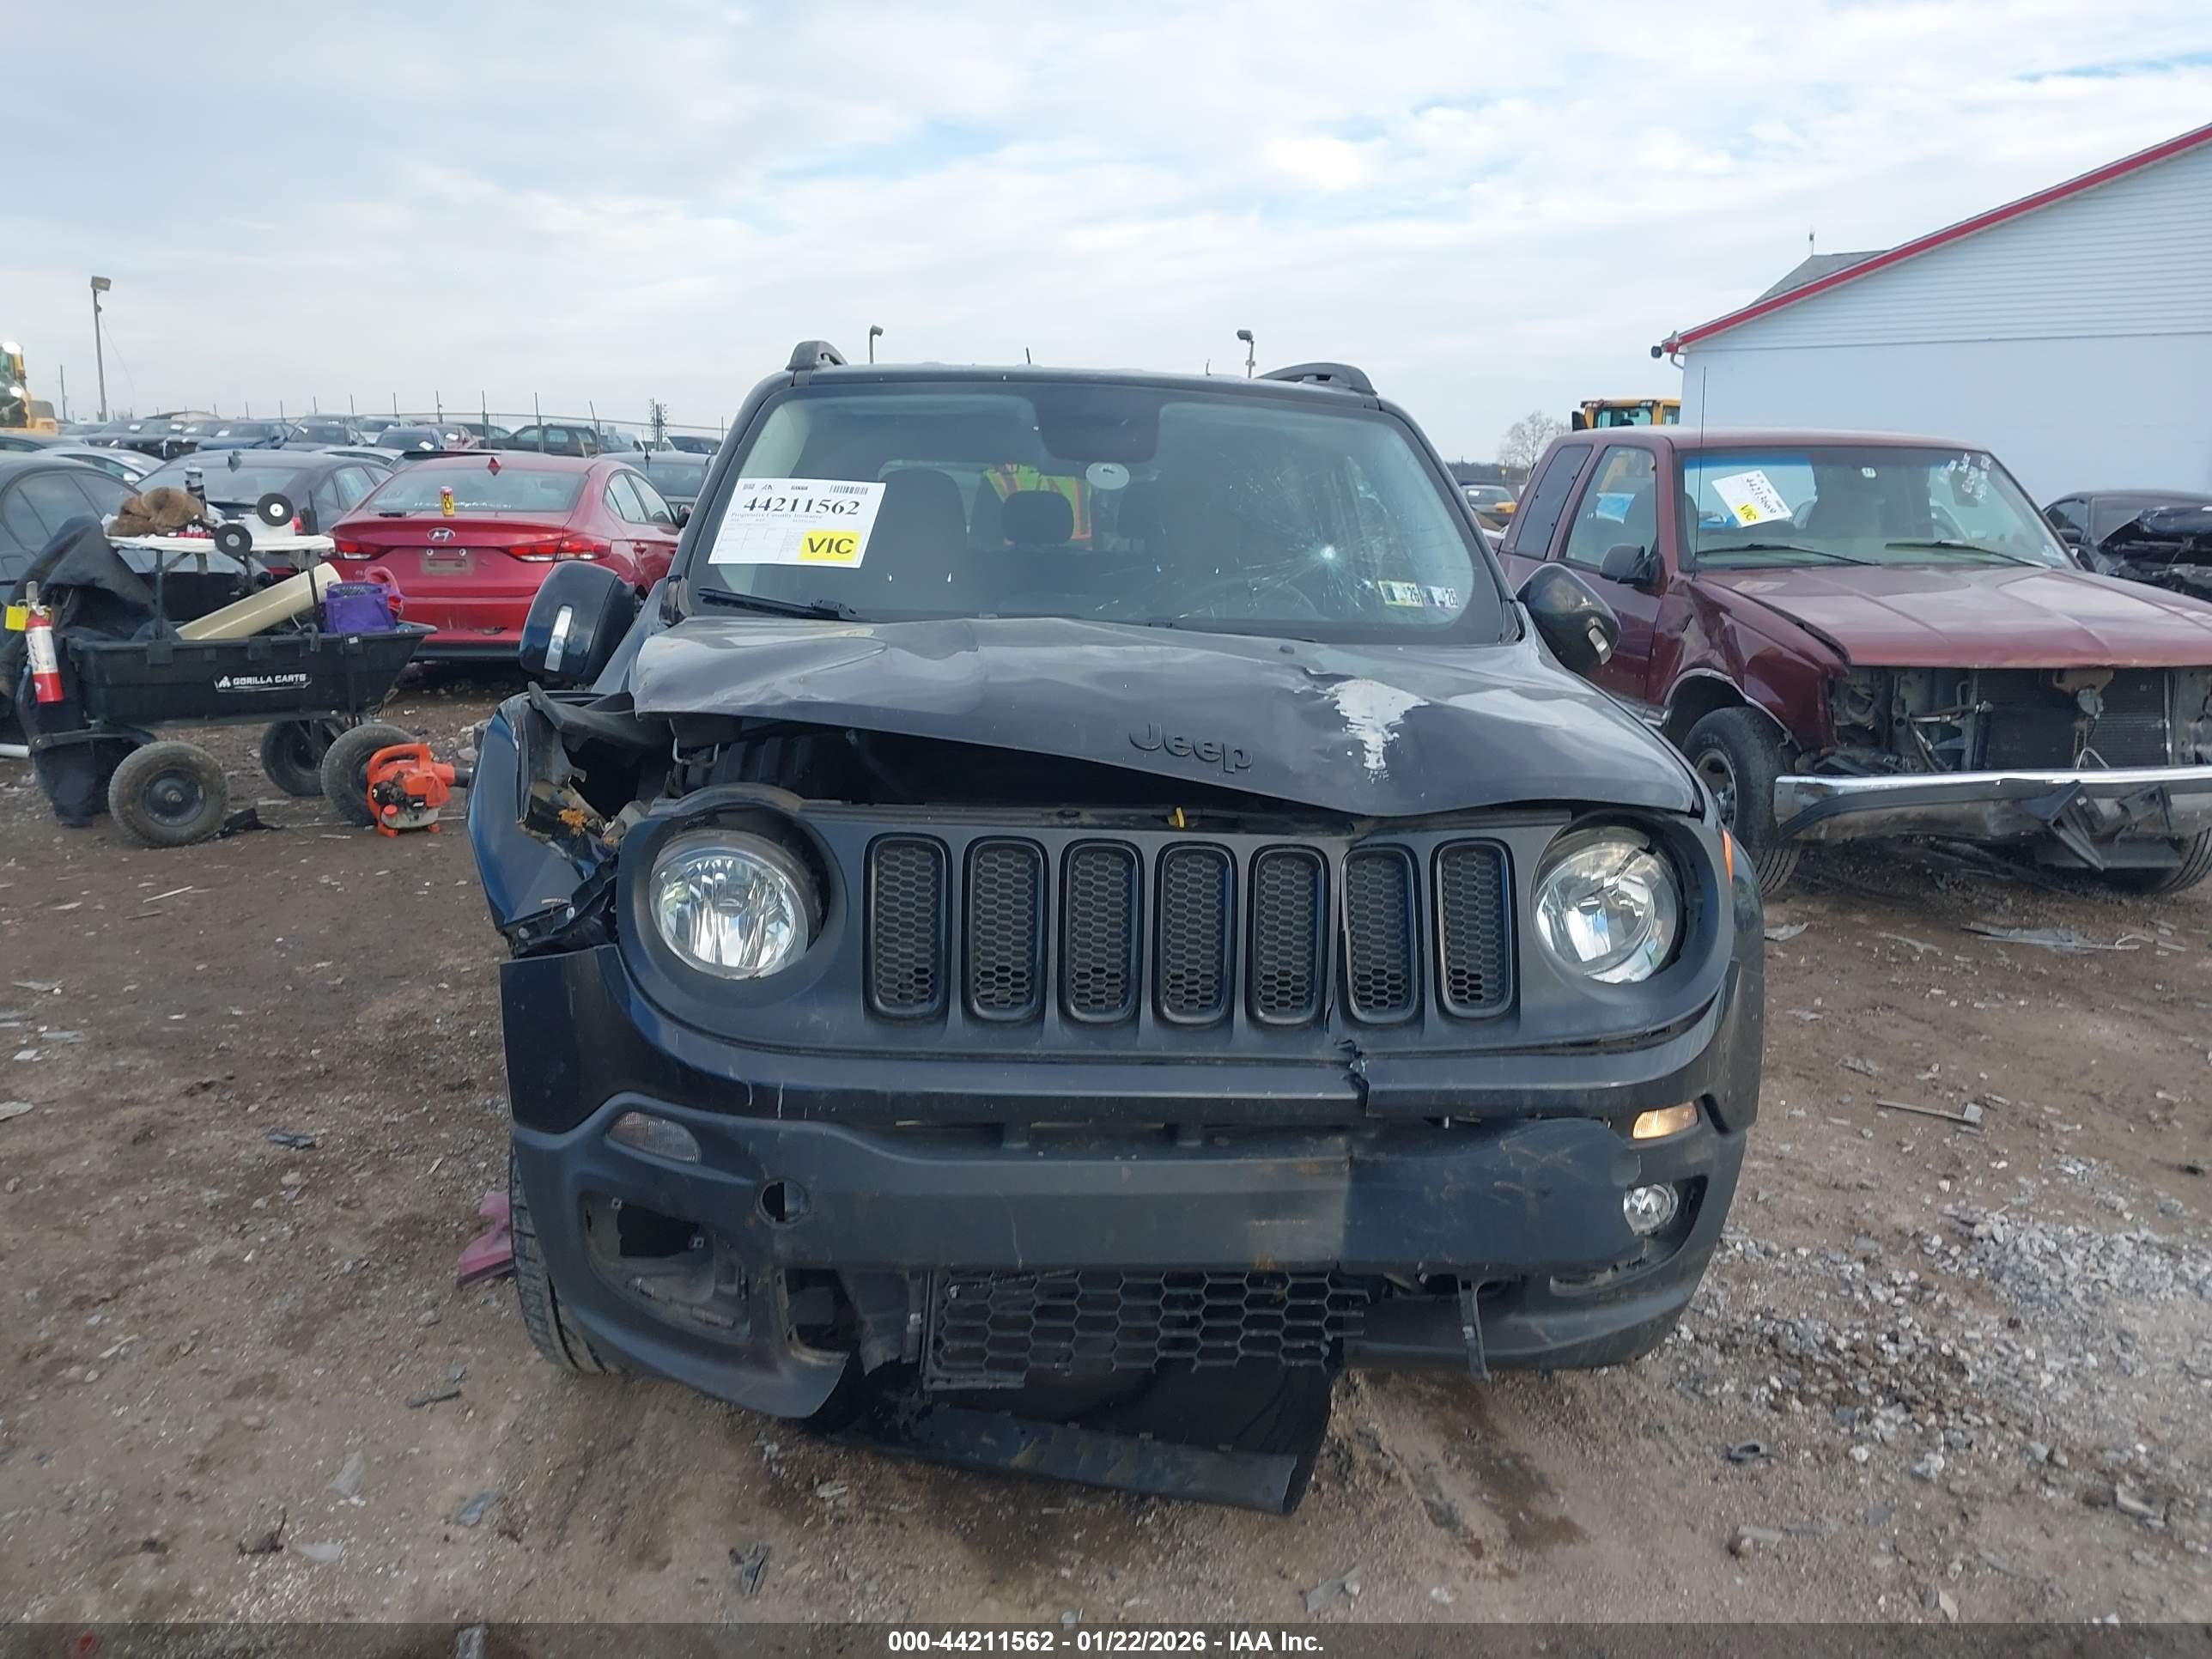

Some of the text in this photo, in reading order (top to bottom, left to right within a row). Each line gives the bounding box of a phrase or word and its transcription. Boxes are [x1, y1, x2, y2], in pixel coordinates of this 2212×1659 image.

[743, 496, 860, 515] 44211562
[807, 538, 854, 555] VIC
[233, 673, 307, 686] GORILLA CARTS
[1128, 721, 1254, 774] Jeep
